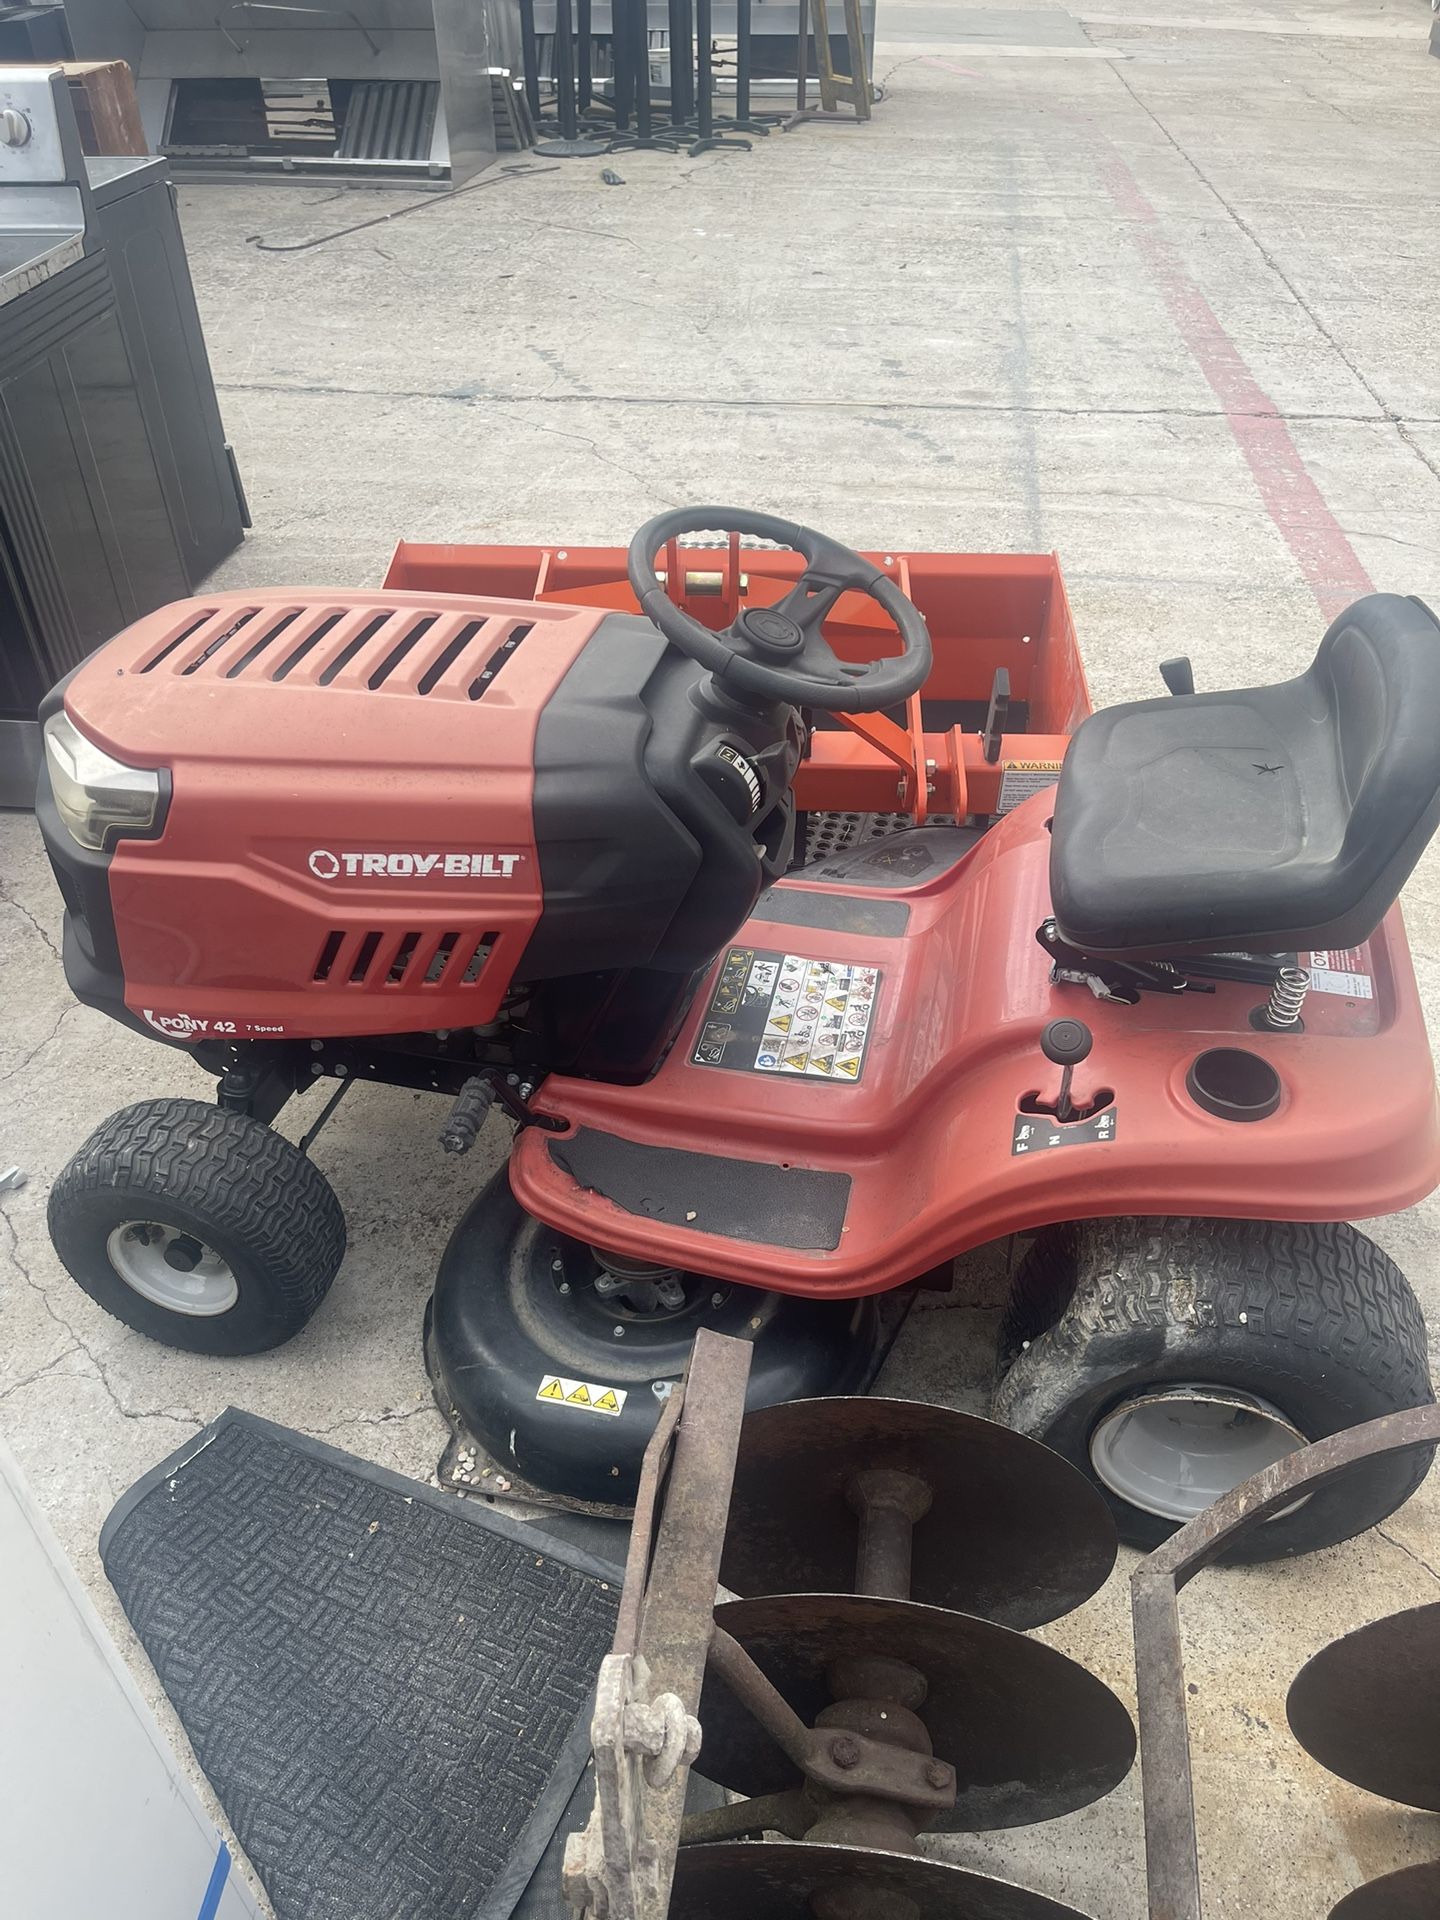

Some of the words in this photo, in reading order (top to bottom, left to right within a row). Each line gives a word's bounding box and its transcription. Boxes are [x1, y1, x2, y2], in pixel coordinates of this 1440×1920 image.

[341, 853, 520, 877] TROY-BILT
[159, 1014, 209, 1032] PONY
[213, 1021, 237, 1033] 42
[255, 1025, 284, 1033] Speed
[1098, 1130, 1109, 1139] R
[1049, 1135, 1060, 1145] N
[1016, 1143, 1028, 1152] F
